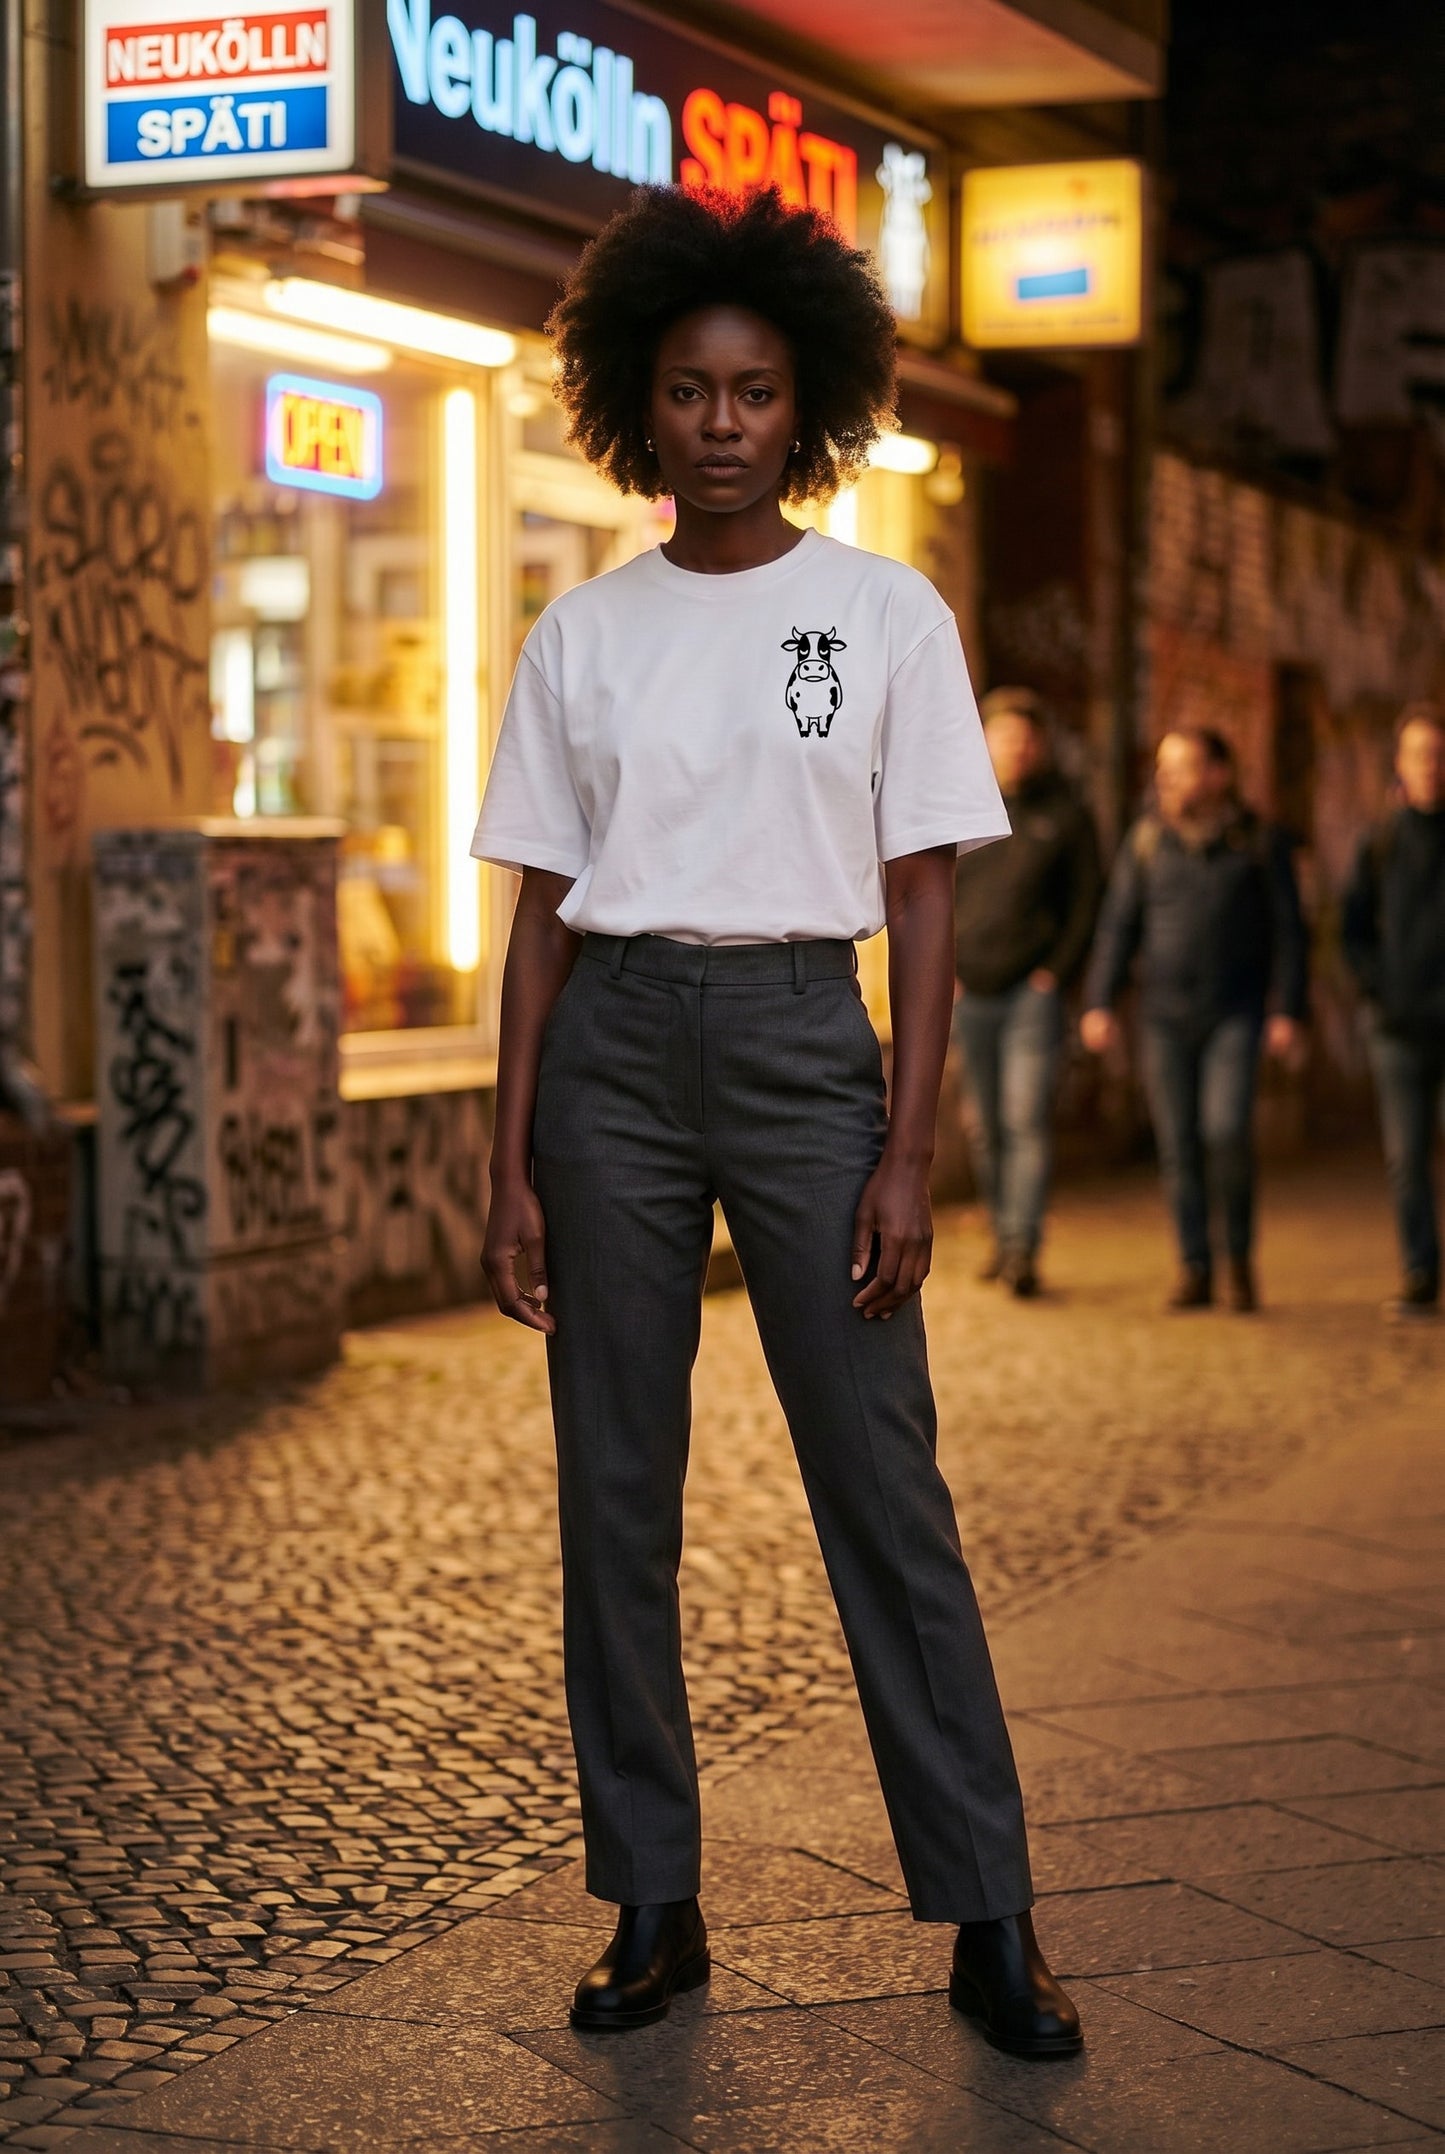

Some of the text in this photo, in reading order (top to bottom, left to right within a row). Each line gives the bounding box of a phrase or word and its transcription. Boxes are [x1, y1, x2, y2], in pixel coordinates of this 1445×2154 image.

[107, 20, 327, 82] NEUKÖLLN
[137, 95, 287, 158] SPÄTI
[386, 0, 672, 185] Neukölln
[276, 390, 372, 482] OPEN
